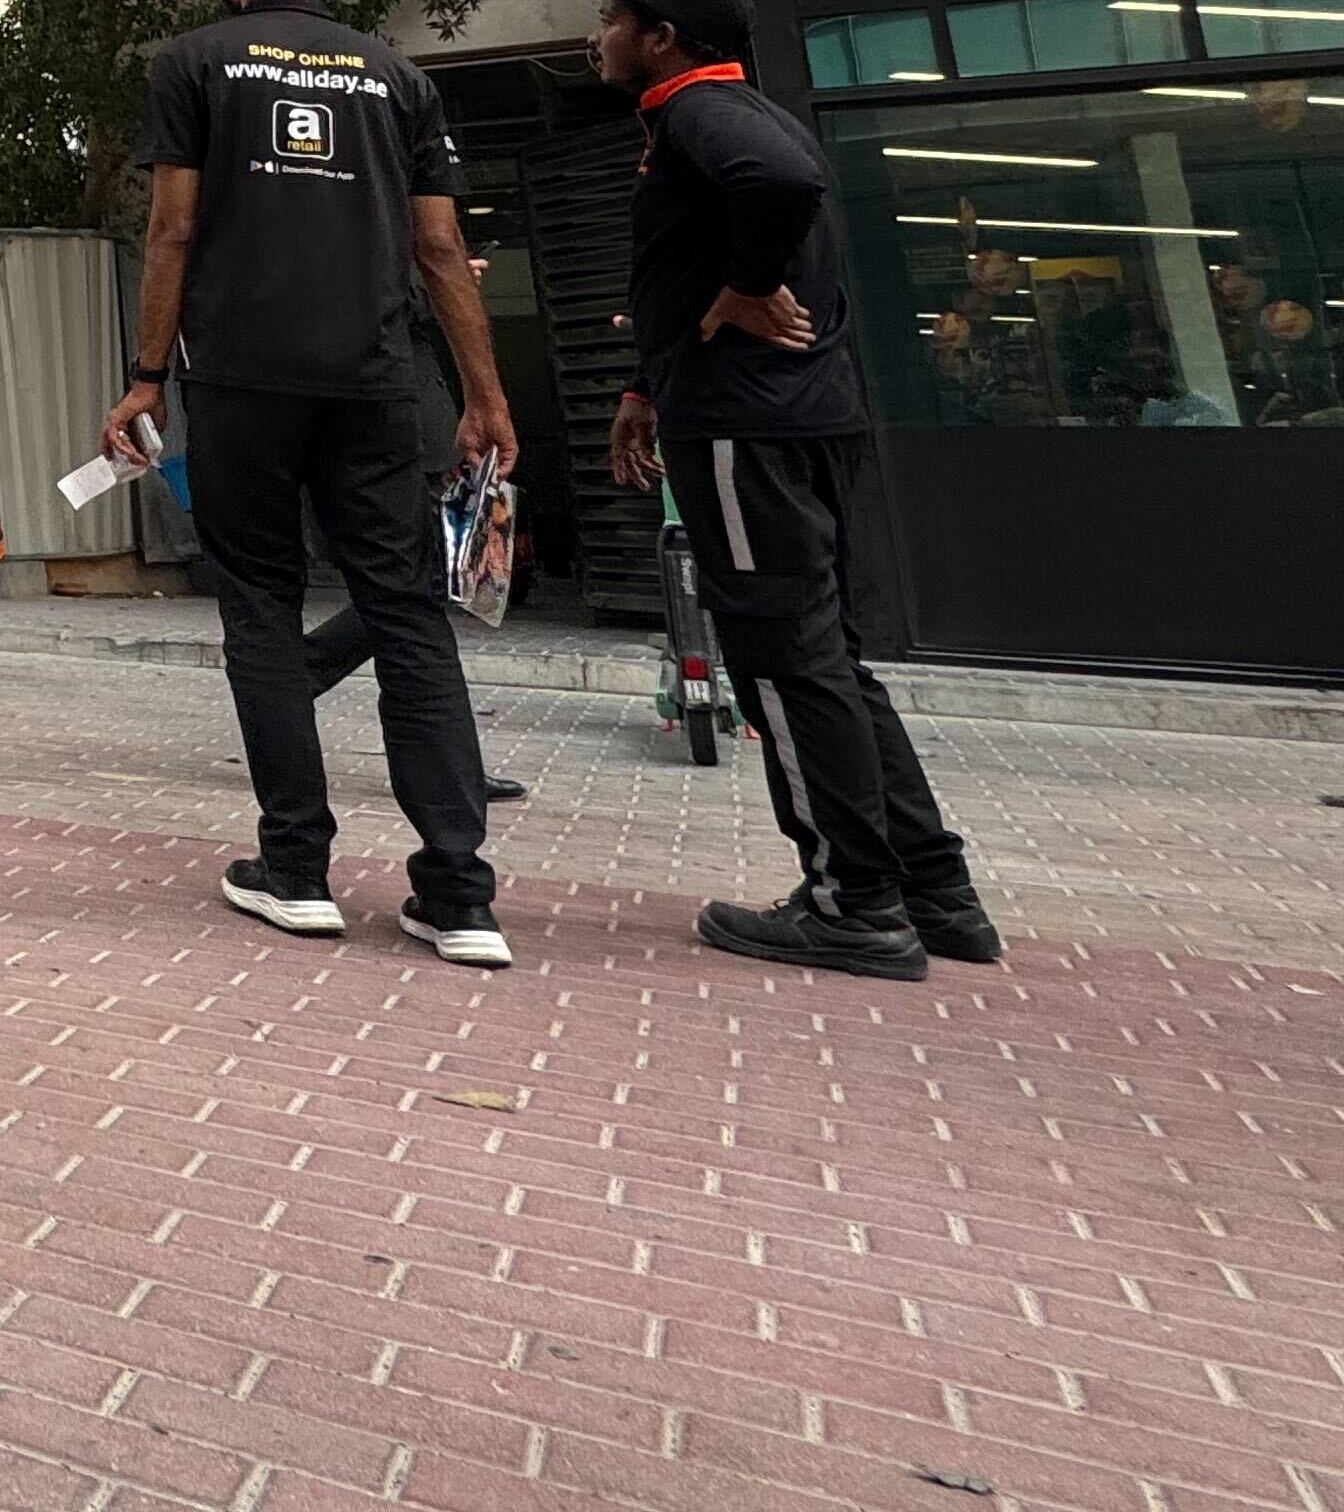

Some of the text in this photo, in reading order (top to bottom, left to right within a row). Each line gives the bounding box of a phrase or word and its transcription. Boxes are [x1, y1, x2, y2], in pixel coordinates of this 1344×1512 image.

[248, 45, 366, 69] SHOP ONLINE
[224, 63, 388, 98] www.allday.ae
[287, 107, 322, 140] a
[287, 140, 322, 152] retail
